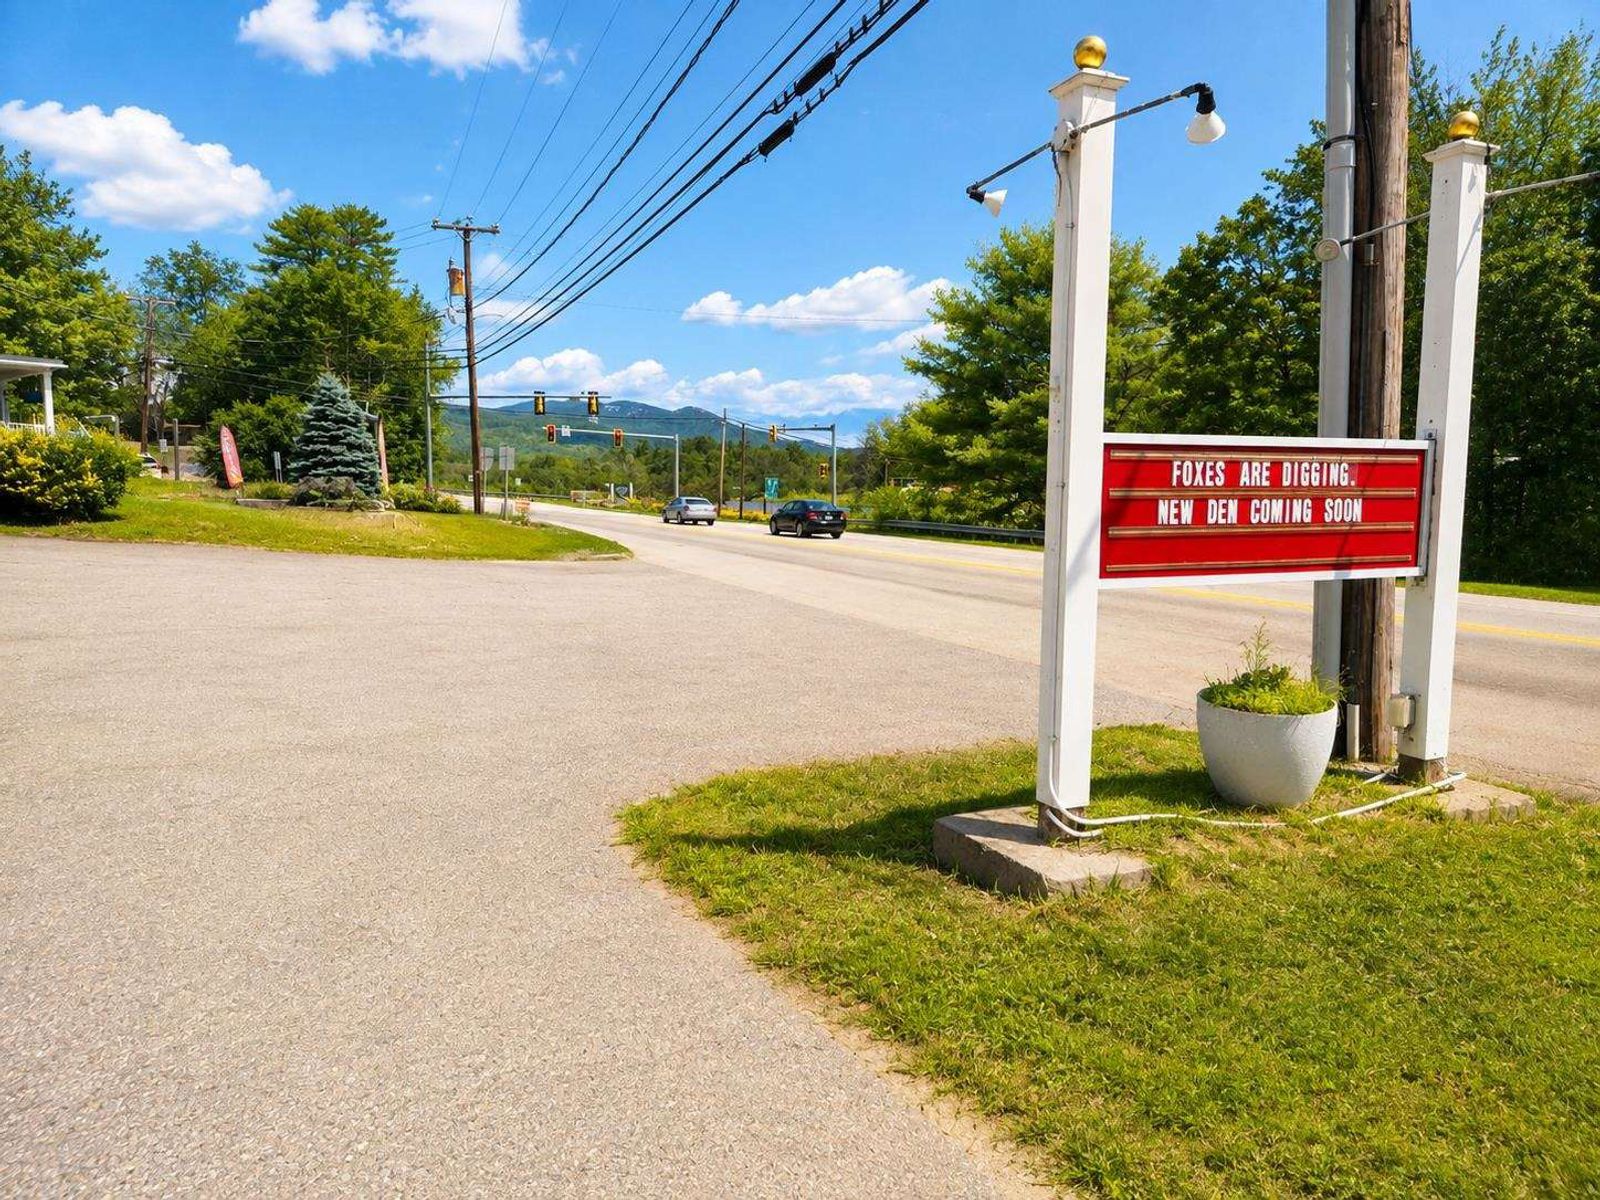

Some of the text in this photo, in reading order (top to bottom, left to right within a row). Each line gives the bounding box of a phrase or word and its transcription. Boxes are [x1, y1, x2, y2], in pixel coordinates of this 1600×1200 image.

[1172, 460, 1356, 487] FOXES ARE DIGGING.
[1157, 497, 1363, 525] NEW DEN COMING SOON
